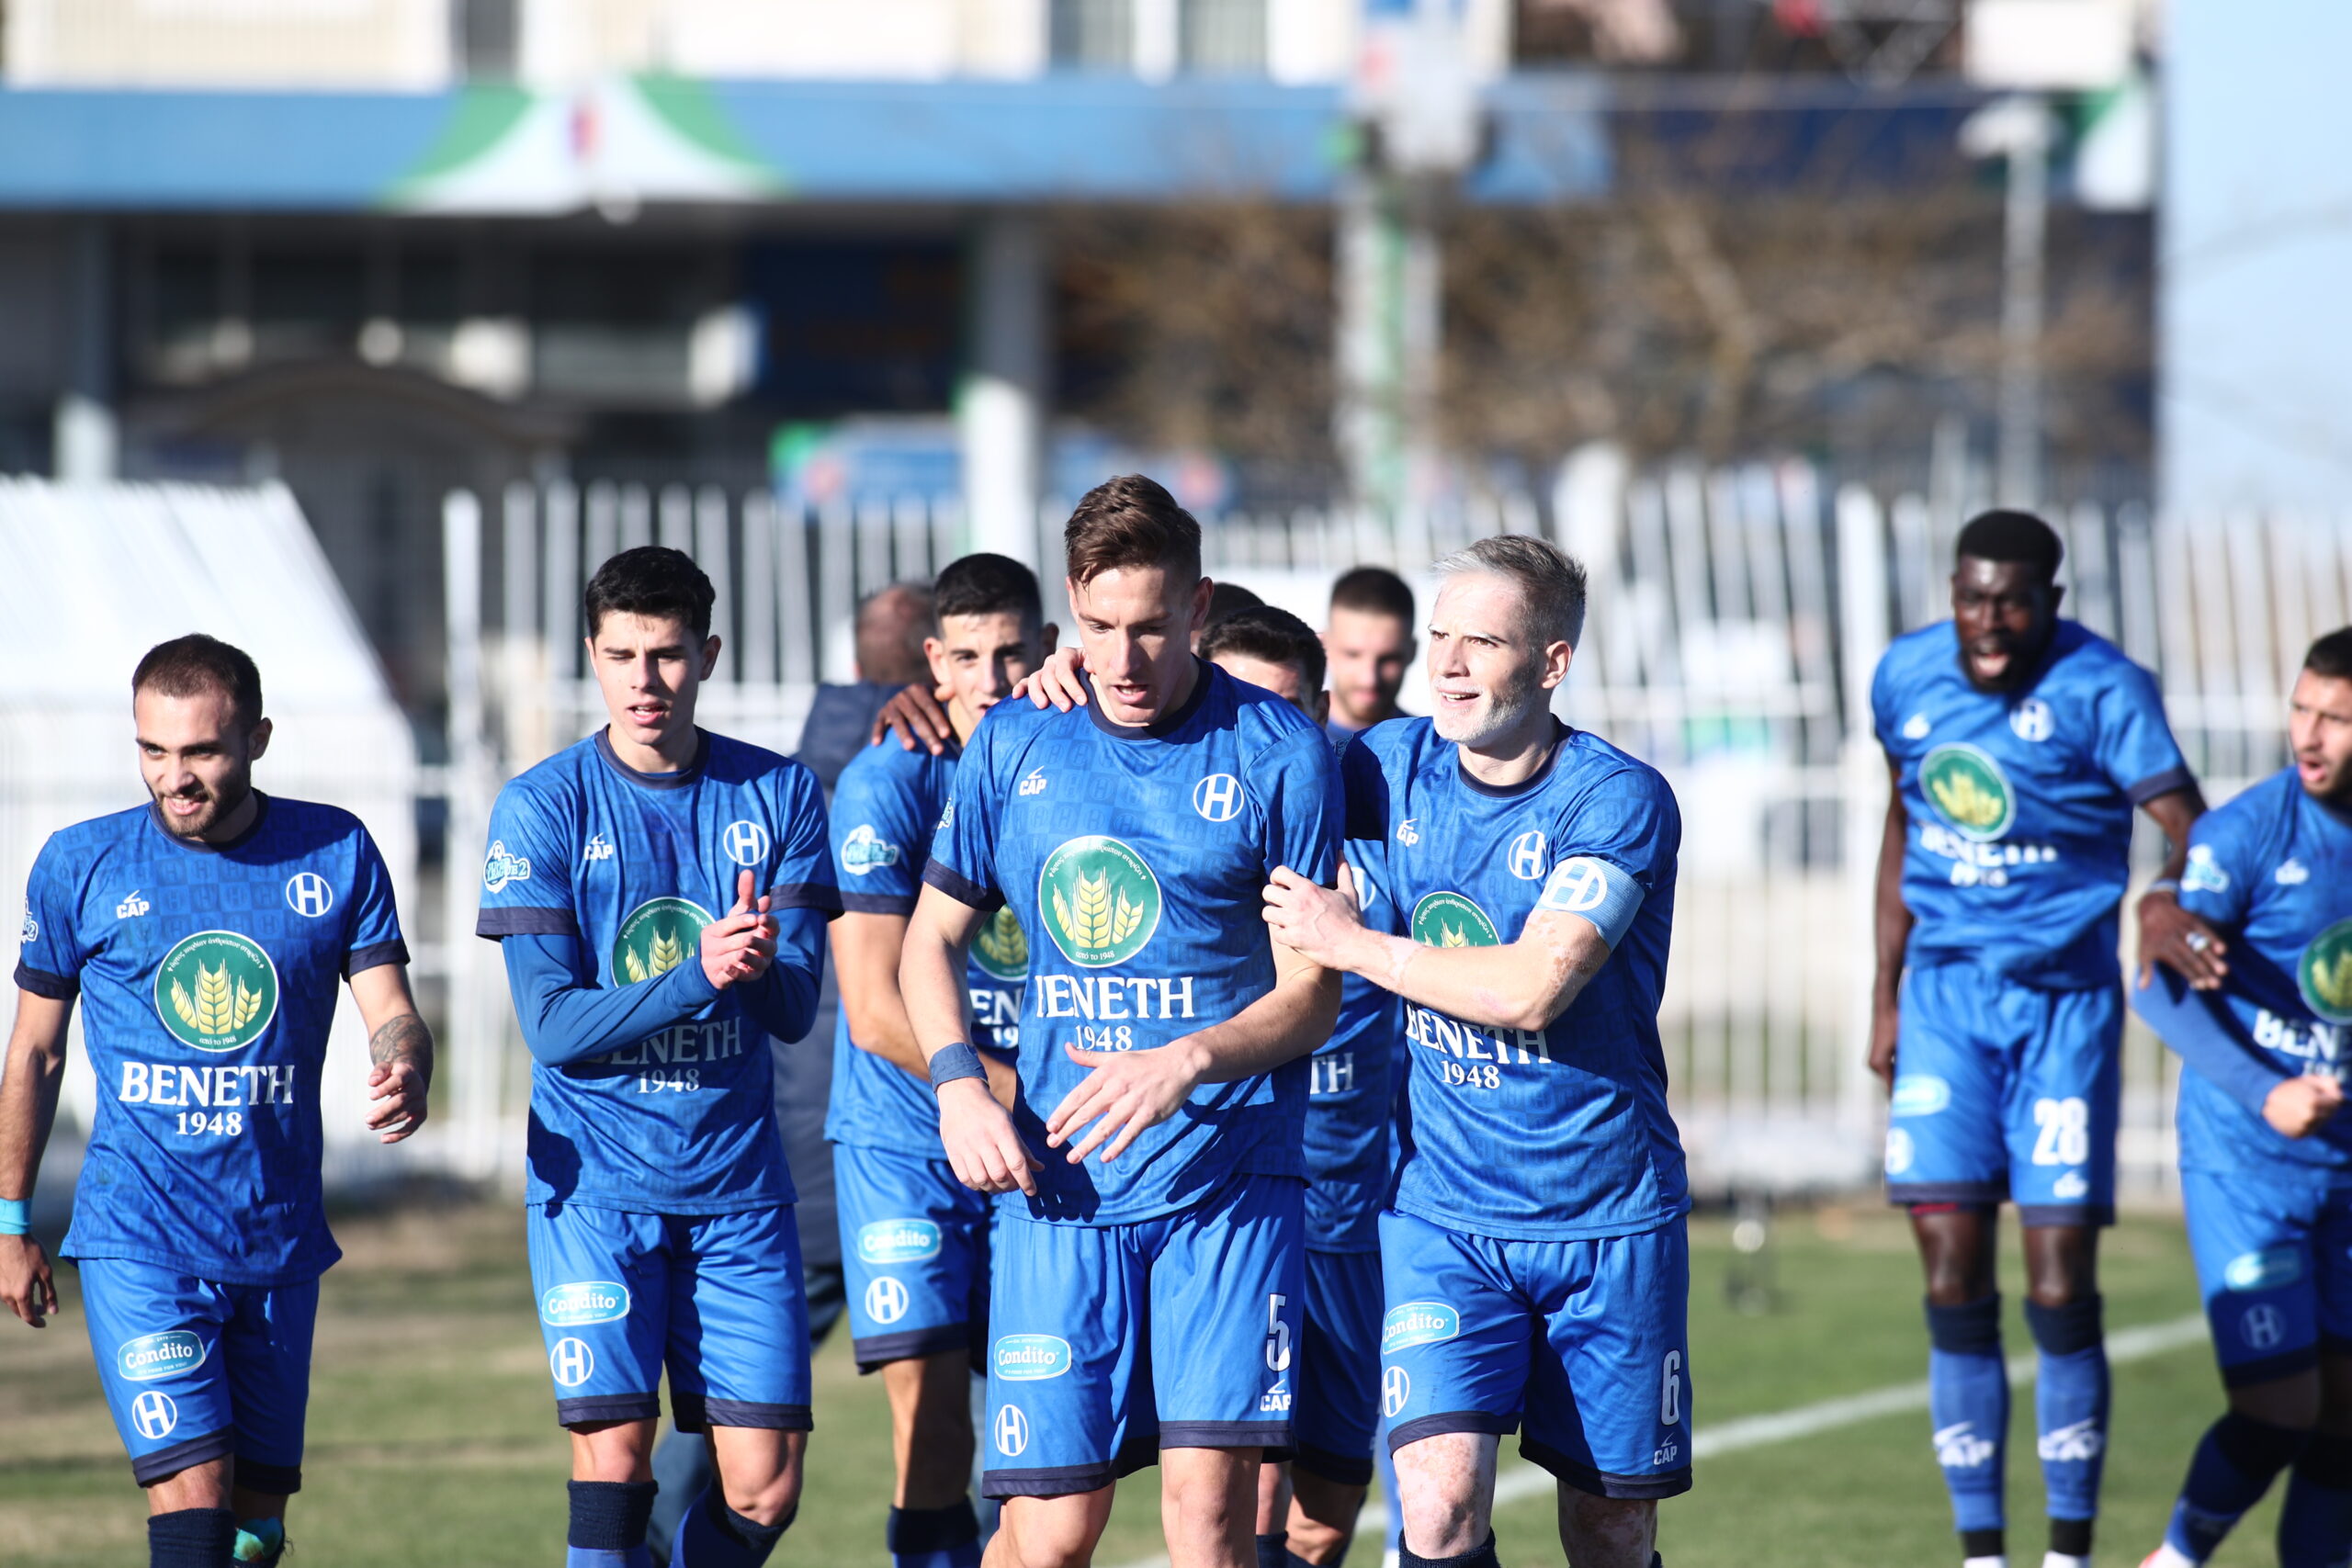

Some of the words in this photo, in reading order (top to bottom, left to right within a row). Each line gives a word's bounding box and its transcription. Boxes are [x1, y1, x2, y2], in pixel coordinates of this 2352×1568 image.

[1019, 778, 1046, 795] CAP
[117, 901, 150, 919] CAP
[1100, 950, 1115, 961] 1948
[1075, 1025, 1133, 1052] 1948
[1405, 1004, 1552, 1065] BENETH
[119, 1061, 295, 1107] BENETH
[637, 1068, 700, 1094] 1948
[1442, 1060, 1501, 1089] 1948
[175, 1111, 243, 1136] 1948
[2031, 1096, 2089, 1166] 28
[548, 1292, 616, 1314] Condito
[1266, 1293, 1291, 1371] 5
[1384, 1313, 1445, 1343] Condito
[125, 1342, 193, 1370] Condito
[998, 1345, 1057, 1367] Condito
[1661, 1349, 1680, 1426] 6
[1260, 1394, 1292, 1411] CAP
[1654, 1445, 1678, 1465] CAP
